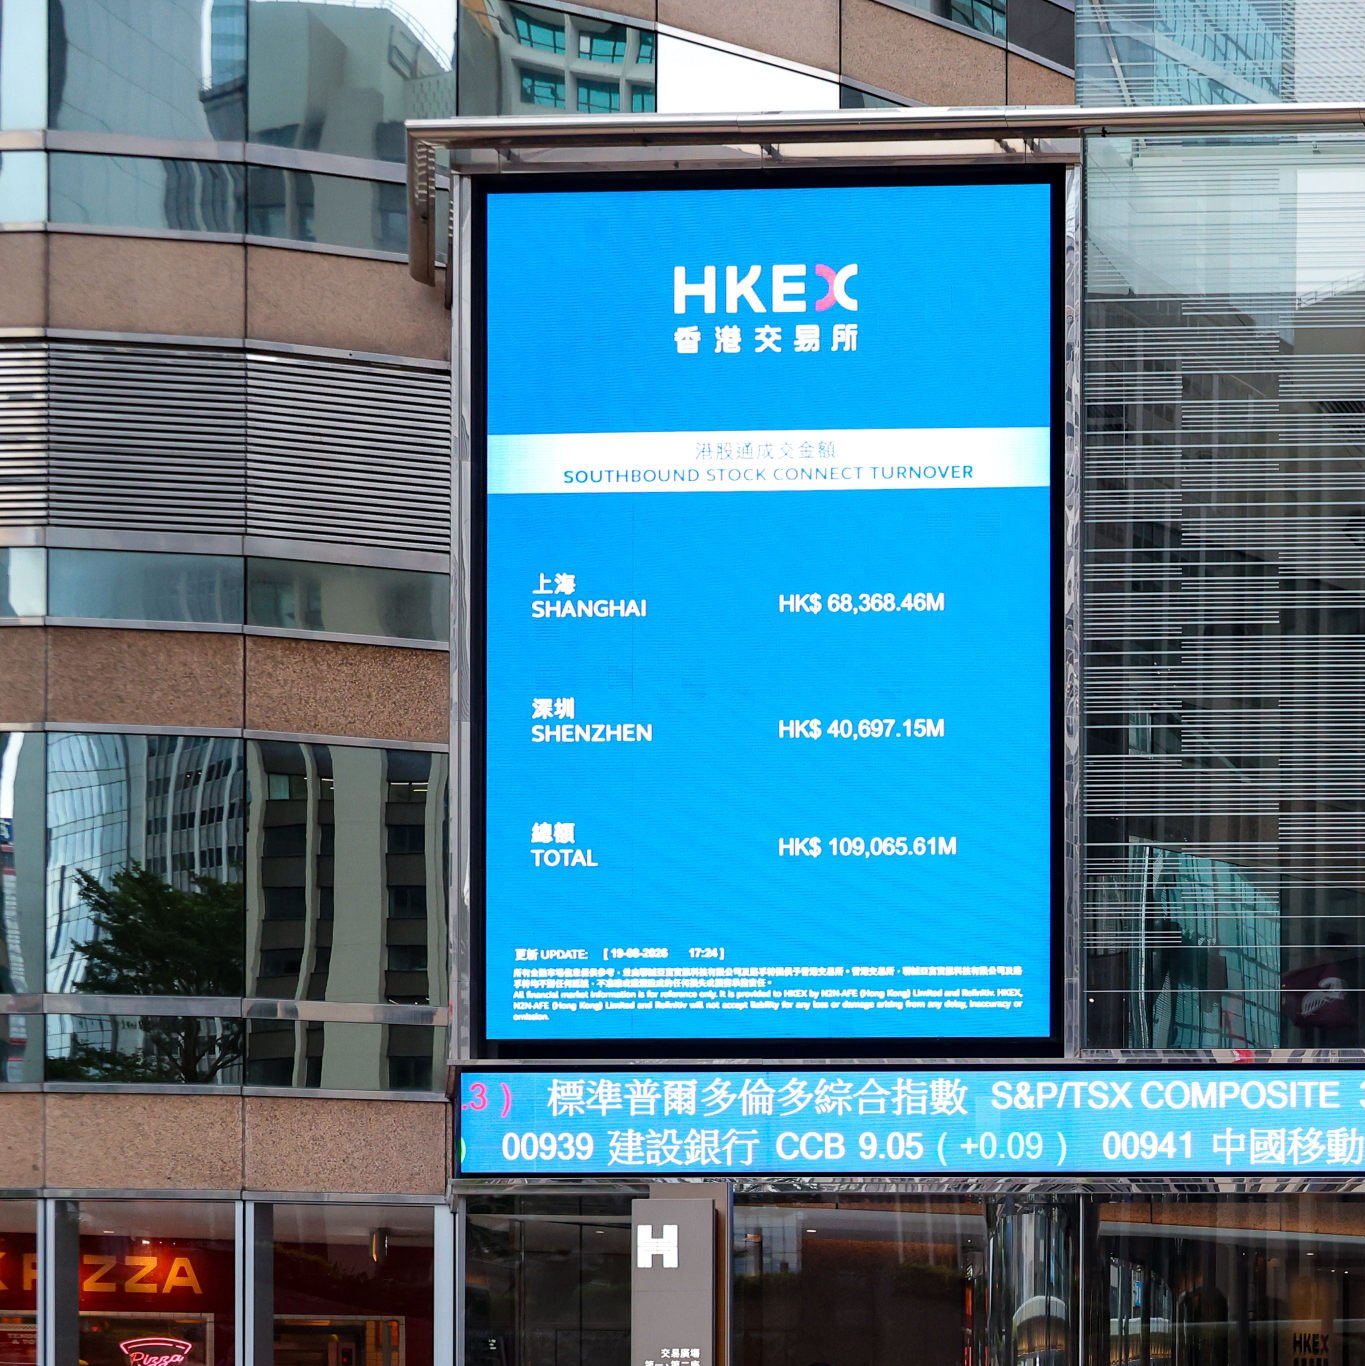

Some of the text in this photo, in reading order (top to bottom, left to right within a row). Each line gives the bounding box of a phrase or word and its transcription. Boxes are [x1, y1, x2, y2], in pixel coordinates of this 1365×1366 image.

[674, 264, 857, 313] HKEX
[674, 324, 857, 353] 香港交易所
[696, 441, 835, 460] 港股通成交金額
[563, 464, 973, 484] SOUTHBOUND STOCK CONNECT TURNOVER
[533, 573, 575, 594] 上海
[532, 600, 646, 618] SHANGHAI
[780, 593, 944, 614] HK$ 68,368.46M
[532, 698, 574, 719] 深圳
[532, 724, 652, 742] SHENZHEN
[779, 719, 944, 740] HK$ 40,697.15M
[531, 849, 598, 866] TOTAL
[779, 837, 956, 858] HK$ 109,065.61M
[541, 948, 718, 959] UPDATE: 17:24
[548, 1078, 967, 1116] 標準普爾多倫多綜合指數
[992, 1081, 1132, 1109] S&P/TSX
[1141, 1081, 1340, 1109] COMPOSITE
[503, 1133, 593, 1160] 00939
[608, 1129, 759, 1165] 建設銀行
[777, 1132, 845, 1159] CCB
[859, 1132, 923, 1159] 9.05
[961, 1132, 1042, 1158] +0.09
[1103, 1132, 1191, 1159] 00941
[1213, 1127, 1364, 1165] 中國移動
